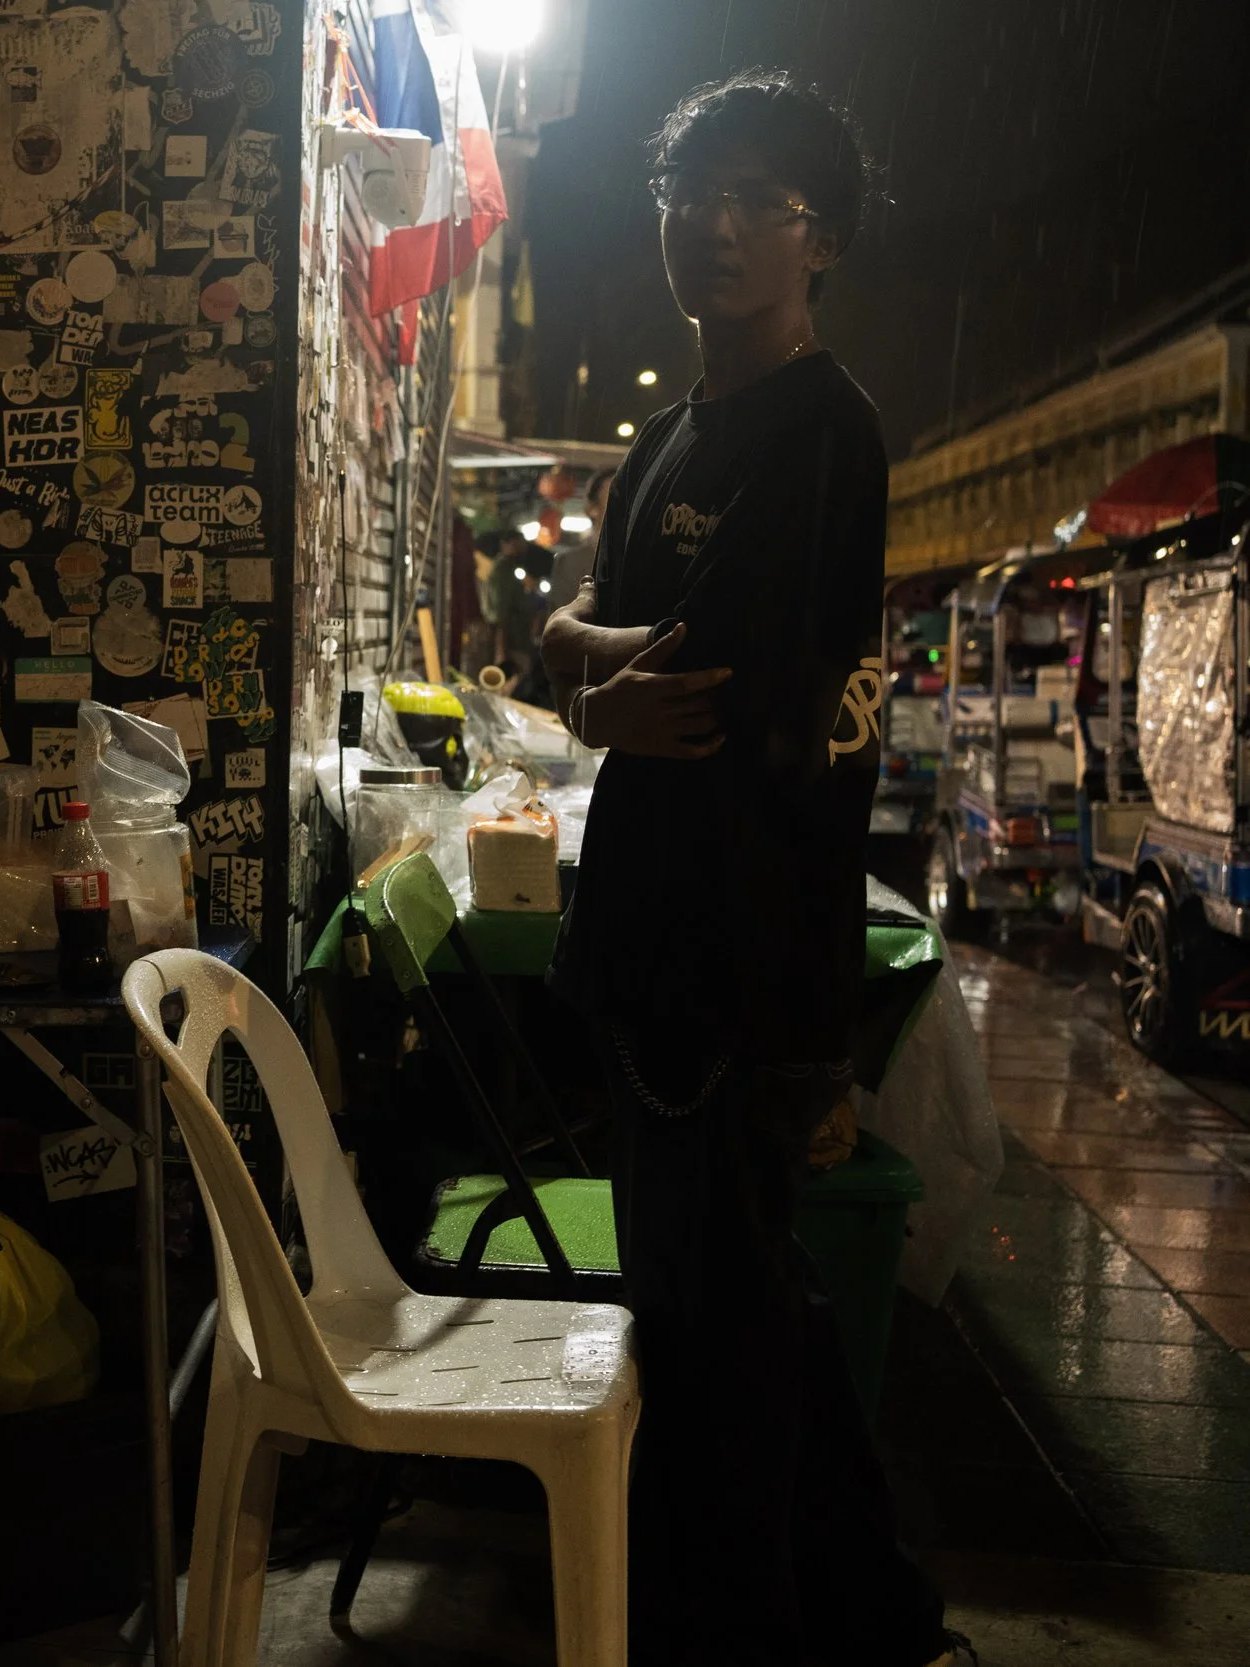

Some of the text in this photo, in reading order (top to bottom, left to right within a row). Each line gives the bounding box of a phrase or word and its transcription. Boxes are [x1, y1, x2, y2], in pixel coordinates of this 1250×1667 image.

[8, 410, 80, 437] NEAS
[25, 483, 37, 496] a
[149, 486, 221, 503] acrux
[150, 505, 221, 522] team
[209, 522, 266, 547] TEENAGE
[34, 661, 75, 669] HELLO
[191, 796, 263, 843] KITY
